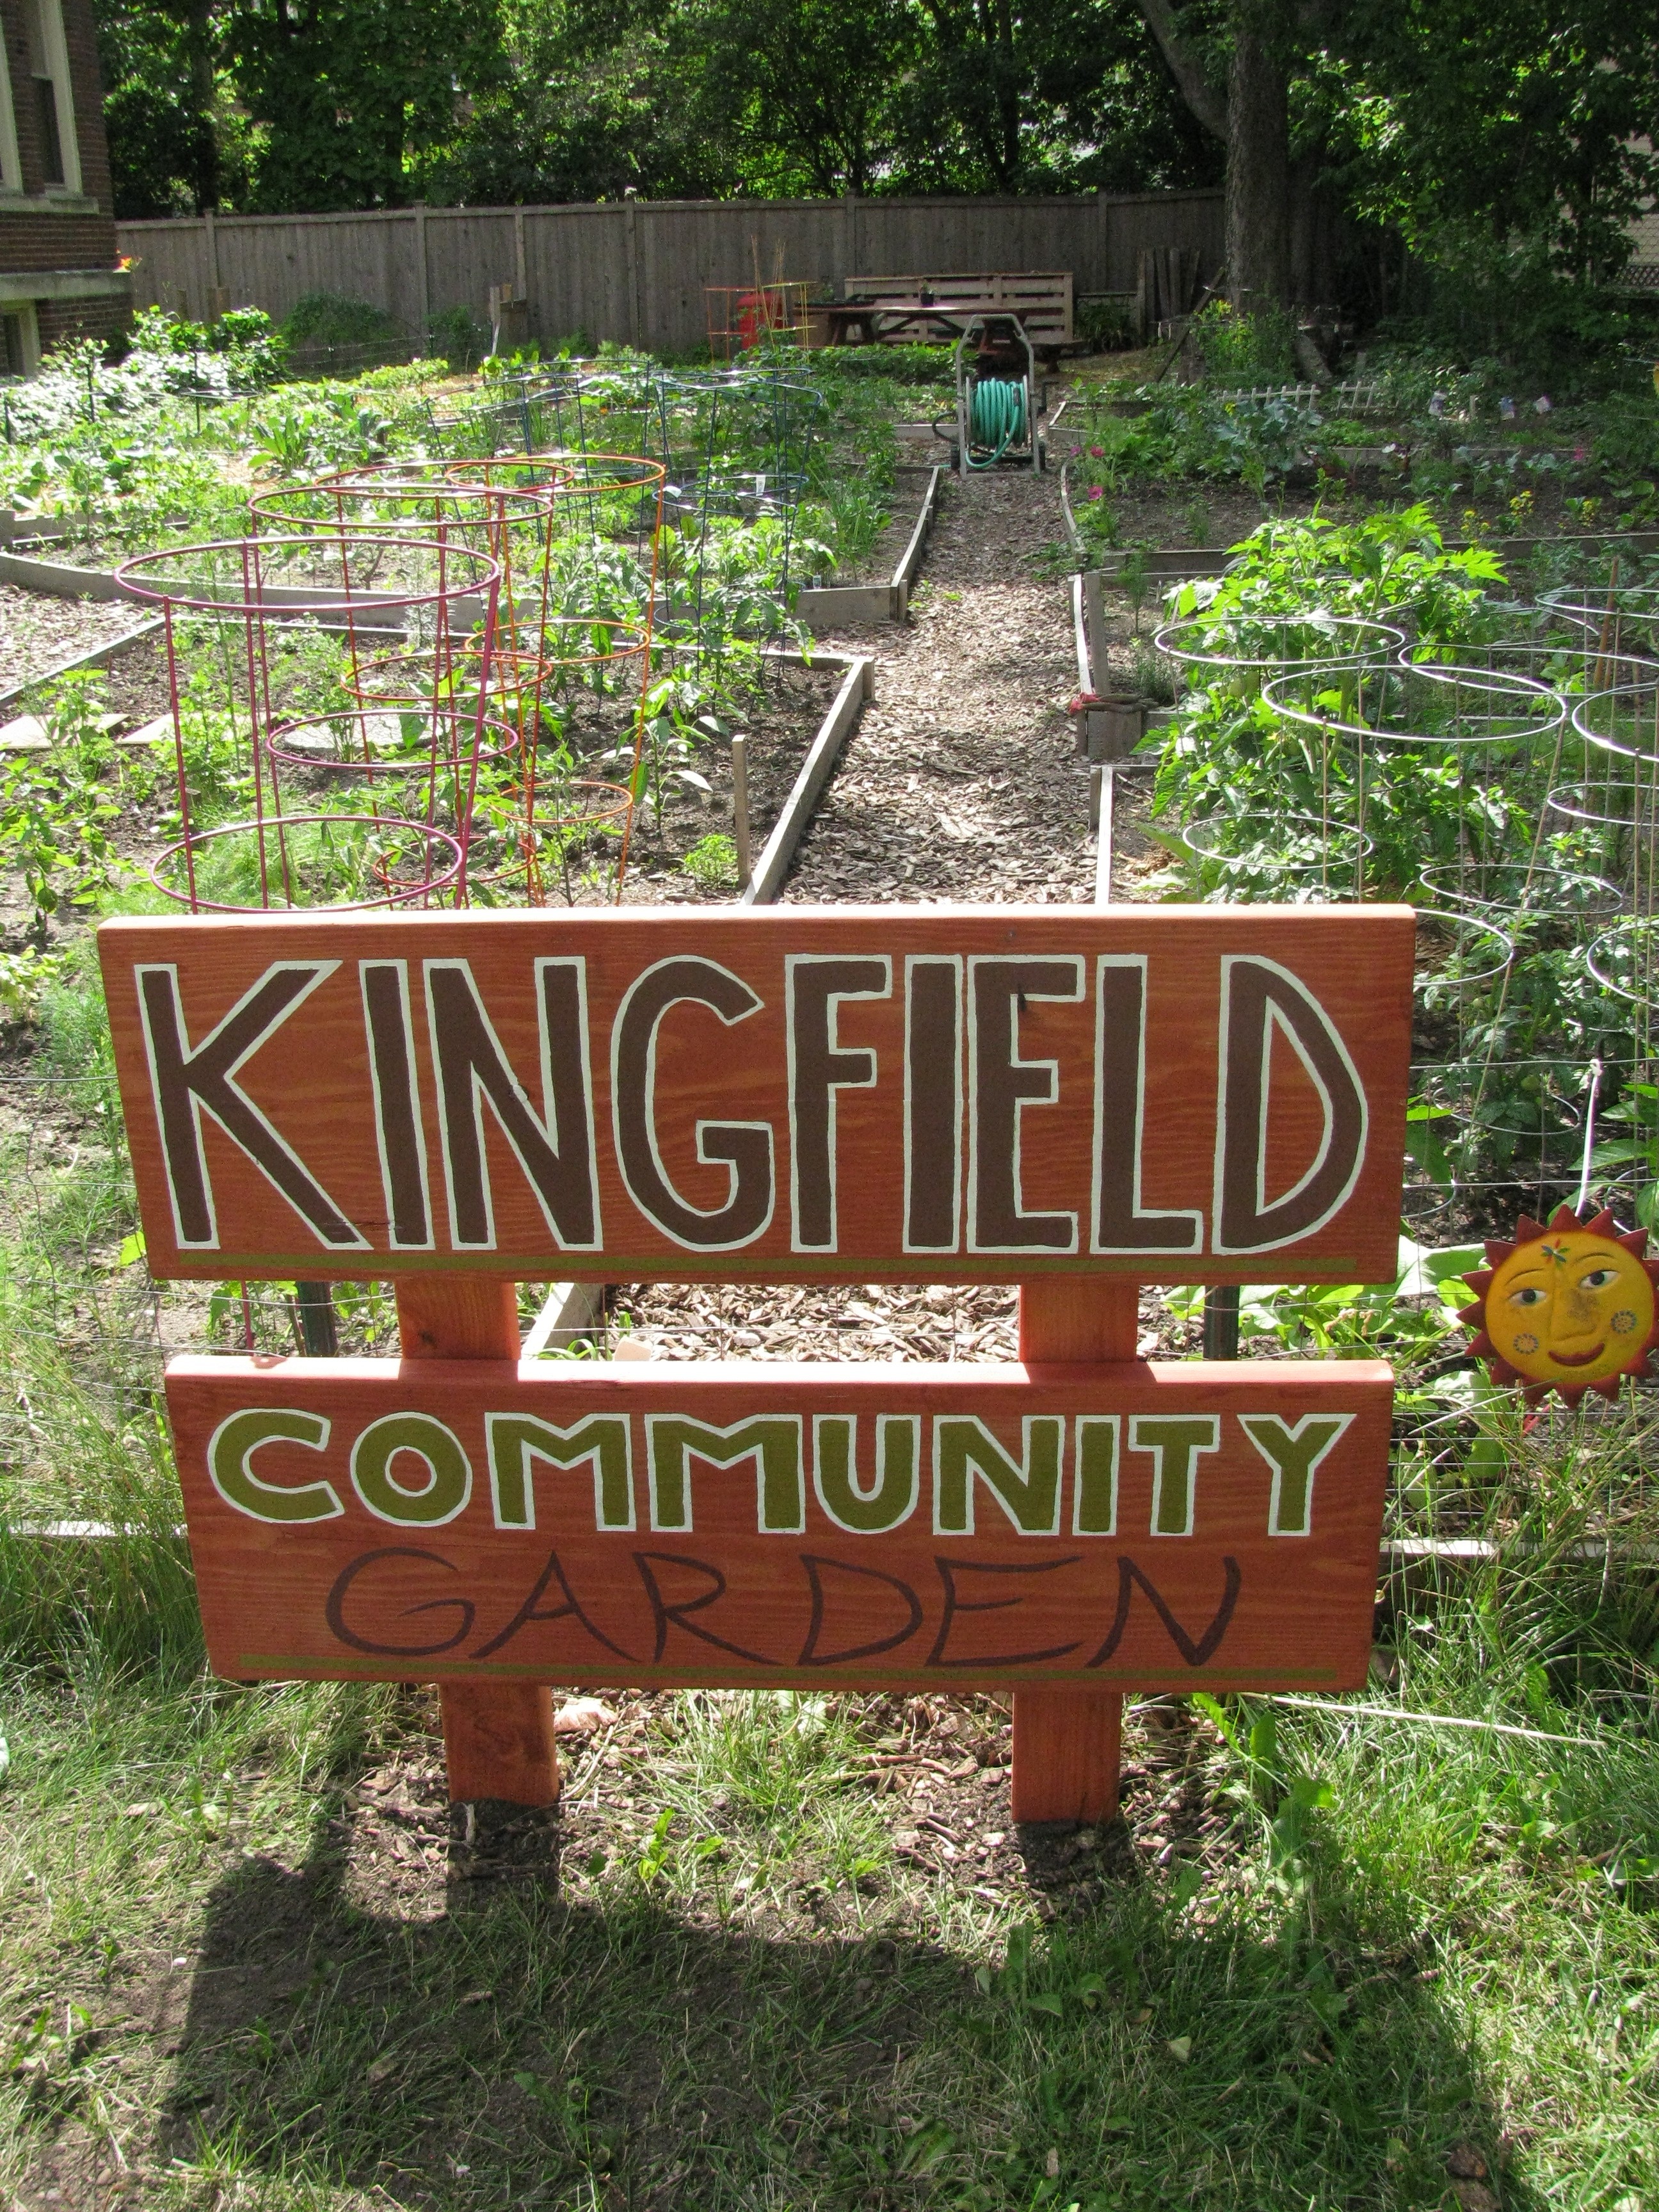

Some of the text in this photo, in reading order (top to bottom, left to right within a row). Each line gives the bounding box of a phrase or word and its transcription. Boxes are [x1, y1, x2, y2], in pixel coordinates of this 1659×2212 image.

[133, 954, 1369, 1256] KINGFIELD
[207, 1409, 1358, 1537] COMMUNITY
[326, 1546, 1242, 1667] GARDEN
